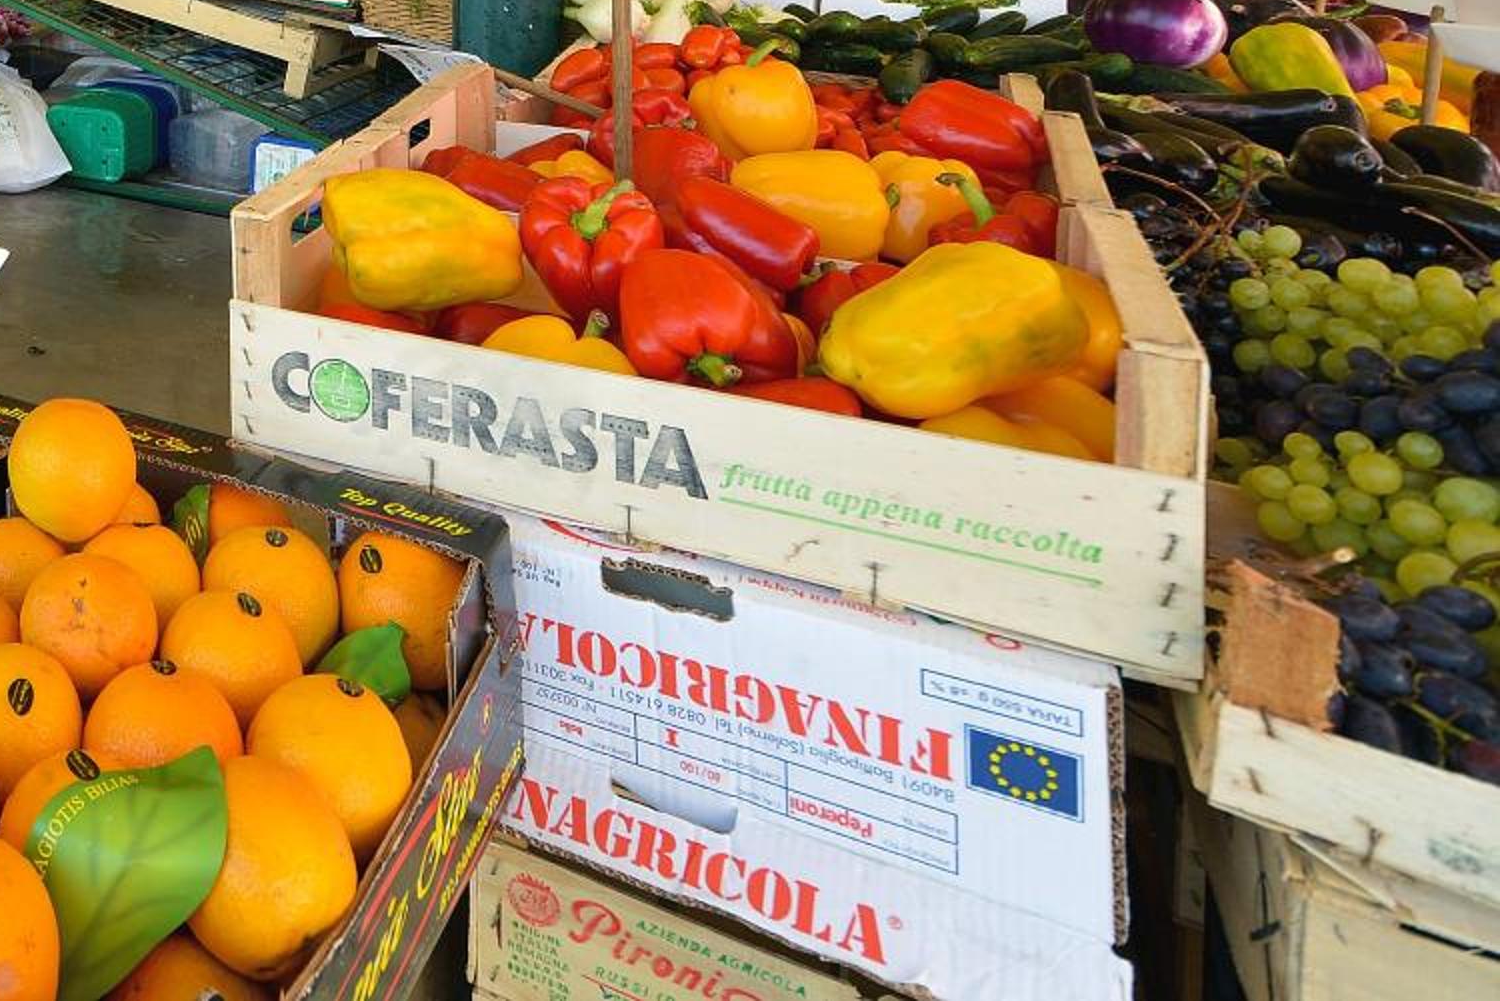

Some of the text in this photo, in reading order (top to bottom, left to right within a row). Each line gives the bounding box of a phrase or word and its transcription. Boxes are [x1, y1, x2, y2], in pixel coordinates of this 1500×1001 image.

[271, 351, 709, 501] COFERASTA
[340, 488, 473, 536] Top Quality
[719, 463, 1103, 565] frutta appena raccolta
[569, 673, 595, 692] Fax
[610, 686, 663, 710] 614511
[667, 703, 706, 726] 0828
[901, 775, 955, 803] 84091
[34, 794, 86, 876] AGIOTIS
[789, 796, 873, 838] Peperoni
[512, 777, 888, 967] NAGRICOLA
[636, 919, 808, 999] AZIENDA AGRICOLA
